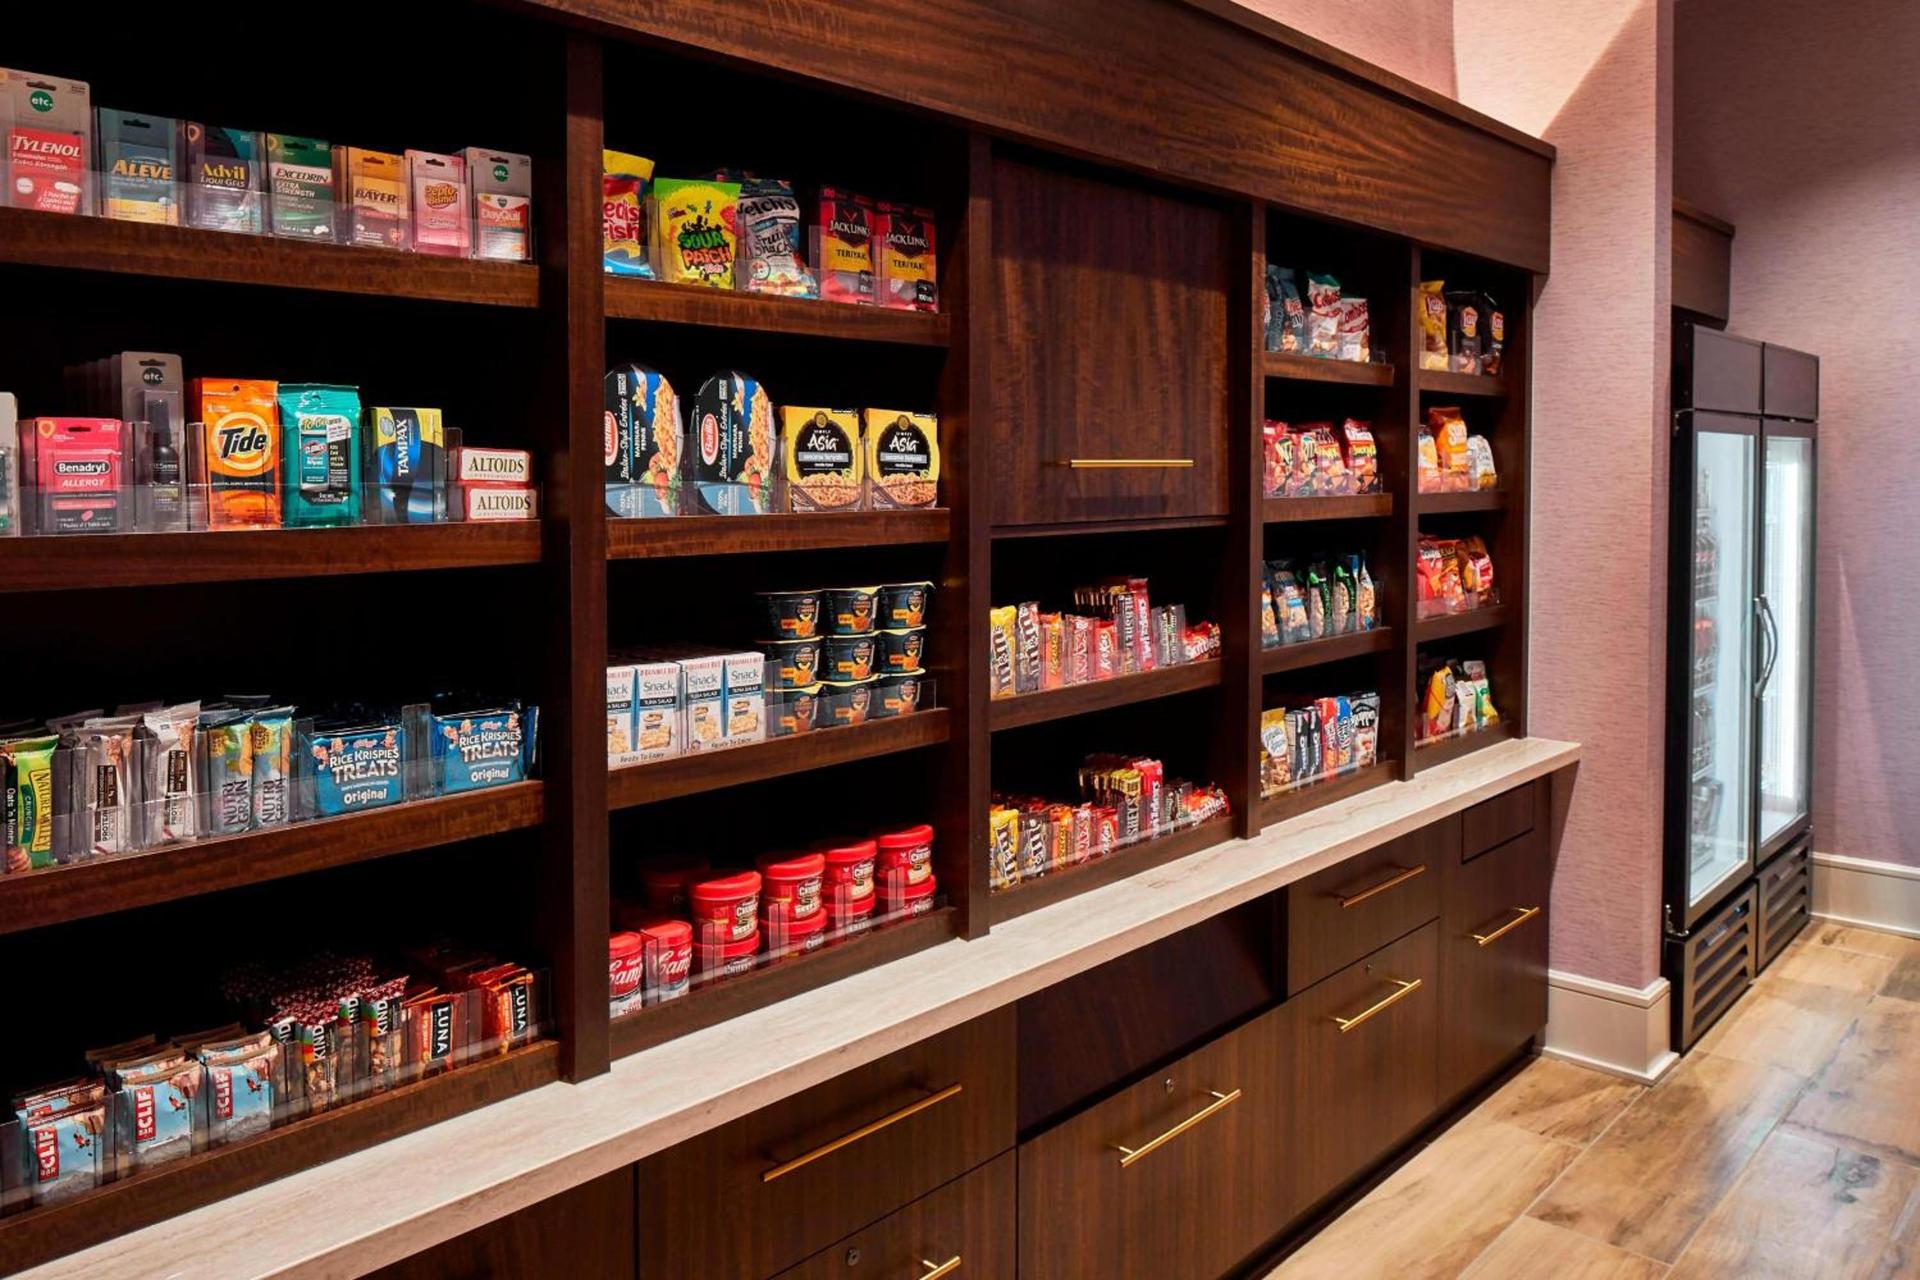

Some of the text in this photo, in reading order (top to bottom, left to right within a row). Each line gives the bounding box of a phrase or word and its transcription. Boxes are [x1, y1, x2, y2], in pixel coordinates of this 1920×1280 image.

[32, 96, 53, 108] etc.
[12, 135, 81, 158] TYLENOL
[112, 159, 172, 181] ALEVE
[203, 162, 245, 180] Advil
[276, 168, 329, 183] EXCEDRIN
[276, 181, 300, 189] EXTRA
[276, 187, 316, 198] STRENGTH
[355, 187, 397, 203] BAYER
[425, 184, 457, 196] Pepto
[427, 193, 457, 206] Bismol
[481, 208, 521, 222] DayQuil
[678, 231, 724, 249] SOUR
[682, 246, 733, 268] PATCH
[219, 427, 267, 459] Tide
[704, 415, 714, 453] Barilla
[807, 433, 838, 453] Asia
[888, 435, 919, 453] Asia
[397, 419, 410, 477] TAMPAX
[58, 462, 107, 475] Benadryl
[469, 455, 524, 473] ALTOIDS
[62, 478, 105, 488] ALLERGY
[477, 494, 531, 511] ALTOIDS
[689, 673, 718, 686] Snack
[731, 668, 759, 681] Snack
[643, 680, 675, 692] Snack
[459, 730, 522, 747] RICE KRISPIES
[330, 747, 400, 769] RICE KRISPIES
[461, 741, 520, 763] TREATS
[332, 759, 398, 784] TREATS
[471, 767, 510, 783] Original
[7, 788, 17, 807] Oats
[33, 771, 51, 813] NATURE
[238, 779, 250, 824] GRAIN
[262, 780, 274, 823] NUTRI
[275, 777, 288, 822] GRAIN
[344, 788, 388, 806] Original
[24, 795, 33, 832] CRUNCHY
[223, 782, 237, 825] NUTRI
[7, 819, 17, 845] Honey
[33, 812, 51, 849] VALLEY
[348, 997, 359, 1024] IND
[377, 999, 388, 1036] KIND
[515, 986, 526, 1031] LUNA
[437, 1006, 449, 1054] LUNA
[313, 1025, 326, 1061] KIND
[215, 1070, 230, 1107] CLIF
[137, 1087, 153, 1127] CLIF
[139, 1127, 153, 1136] BAR
[39, 1128, 55, 1169] CLIF
[40, 1168, 56, 1177] BAR
